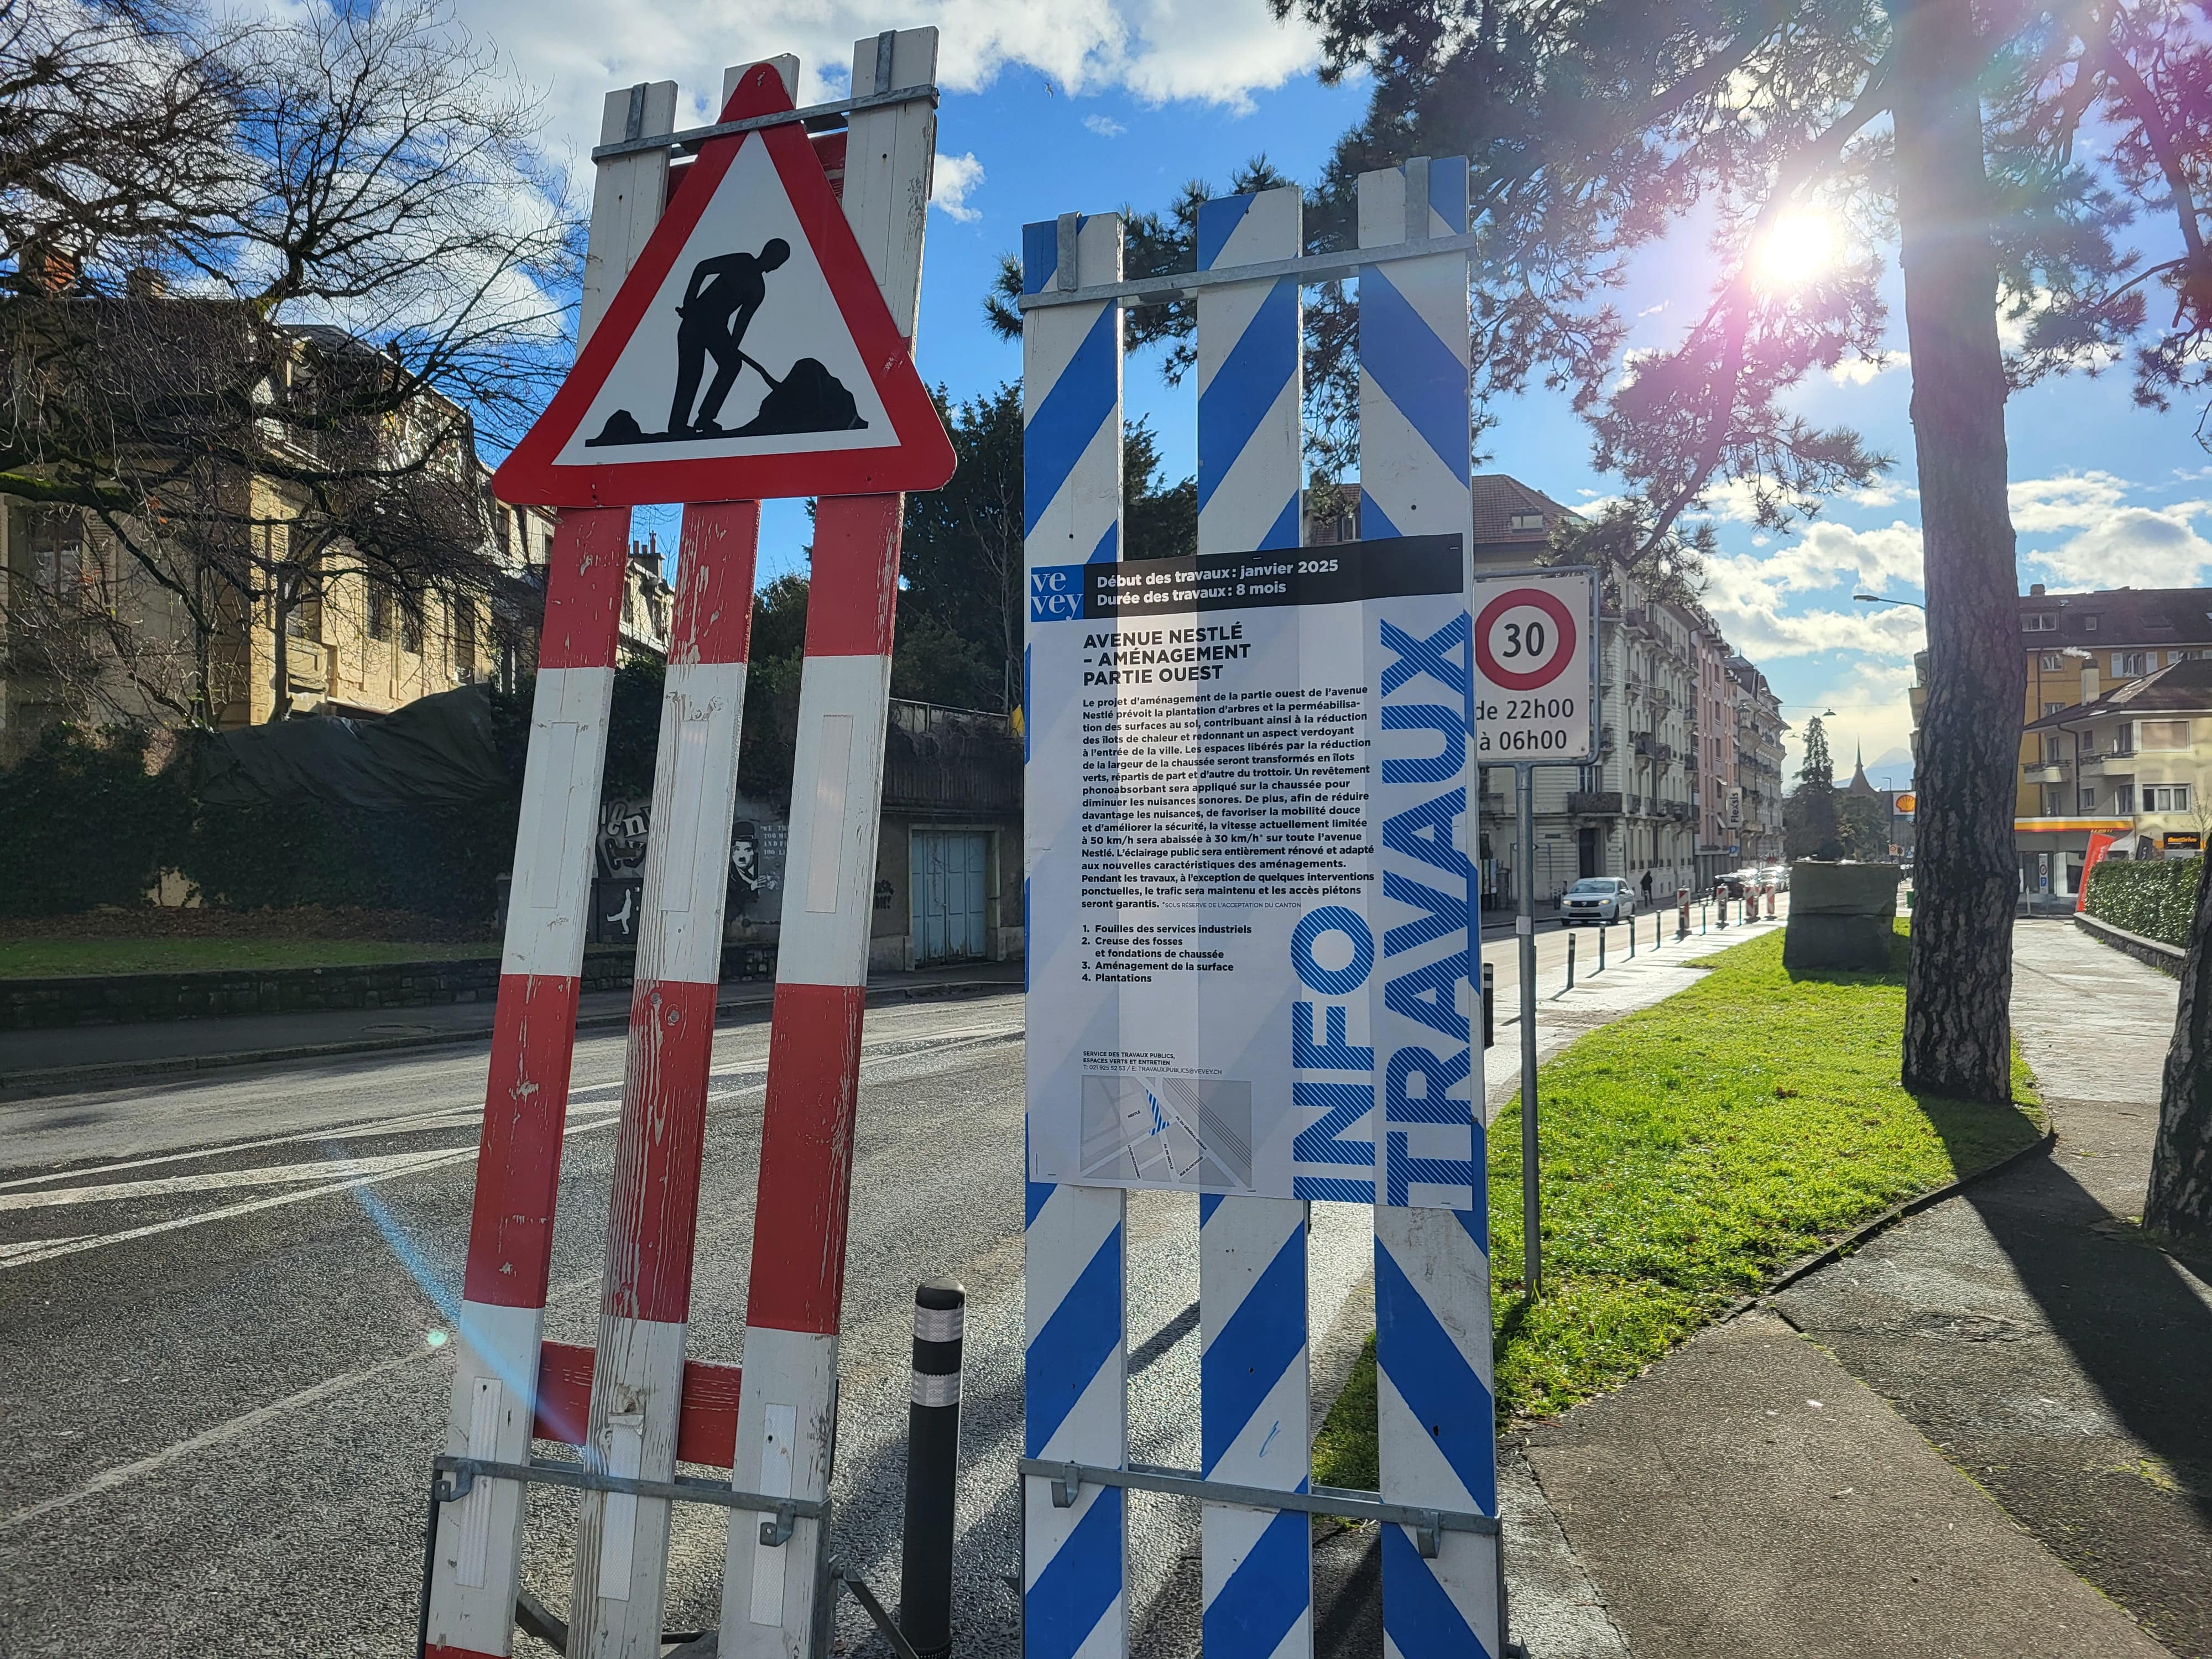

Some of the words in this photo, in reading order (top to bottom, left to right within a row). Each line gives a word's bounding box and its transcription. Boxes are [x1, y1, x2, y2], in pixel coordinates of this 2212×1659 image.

[1097, 573, 1142, 588] Début
[1145, 572, 1172, 586] des
[1239, 562, 1293, 580] janvier
[1298, 559, 1338, 573] 2025
[1097, 591, 1140, 606] Durée
[1143, 590, 1169, 603] des
[1236, 583, 1245, 596] 8
[1249, 581, 1286, 595] mois
[1083, 630, 1163, 649] AVENUE
[1169, 624, 1243, 645] NESTLÉ
[1502, 622, 1545, 658] 30
[1098, 643, 1251, 667] AMÉNAGEMENT
[1083, 669, 1152, 686] PARTIE
[1159, 664, 1223, 683] OUEST
[1083, 698, 1095, 707] Le
[1097, 697, 1128, 708] projet
[1130, 693, 1211, 706] d’aménagement
[1213, 692, 1227, 701] de
[1229, 691, 1238, 701] la
[1241, 690, 1272, 702] partie
[1275, 689, 1306, 698] ouest
[1308, 688, 1322, 697] de
[1325, 687, 1368, 697] l’avenue
[1083, 709, 1114, 720] Nestlé
[1116, 708, 1152, 720] prévoit
[1154, 708, 1163, 717] la
[1166, 706, 1216, 718] plantation
[1218, 704, 1260, 714] d’arbres
[1262, 703, 1274, 712] et
[1276, 702, 1286, 712] la
[1288, 700, 1360, 713] perméabilisa-
[1476, 700, 1498, 721] de
[1506, 698, 1574, 720] 22h00
[1083, 735, 1100, 745] des
[1102, 735, 1124, 744] îlots
[1126, 734, 1139, 744] de
[1141, 733, 1178, 743] chaleur
[1180, 732, 1191, 742] et
[1192, 730, 1244, 741] redonnant
[1262, 728, 1298, 739] aspect
[1300, 726, 1354, 737] verdoyant
[1479, 732, 1491, 751] à
[1499, 729, 1567, 751] 06h00
[1082, 784, 1166, 796] phonoabsorbant
[1168, 785, 1190, 793] sera
[1192, 781, 1237, 794] appliqué
[1259, 781, 1269, 790] la
[1271, 779, 1322, 790] chaussée
[1325, 780, 1350, 790] pour
[1082, 848, 1115, 858] Nestlé.
[1117, 848, 1168, 858] L’éclairage
[1170, 847, 1199, 858] public
[1201, 848, 1222, 857] sera
[1224, 846, 1286, 856] entièrement
[1288, 845, 1324, 855] rénové
[1326, 846, 1337, 855] et
[1339, 844, 1374, 855] adapté
[1102, 860, 1151, 870] nouvelles
[1154, 859, 1235, 871] caractéristiques
[1238, 859, 1256, 869] des
[1259, 859, 1346, 870] aménagements.
[1082, 874, 1122, 883] Pendant
[1124, 874, 1138, 883] les
[1140, 874, 1178, 884] travaux,
[1180, 873, 1186, 883] à
[1188, 873, 1241, 884] l’exception
[1243, 872, 1256, 881] de
[1258, 872, 1305, 883] quelques
[1307, 872, 1374, 882] interventions
[1081, 886, 1142, 897] ponctuelles,
[1145, 886, 1154, 895] le
[1156, 886, 1182, 895] trafic
[1207, 886, 1255, 895] maintenu
[1258, 886, 1269, 895] et
[1271, 885, 1286, 895] les
[1289, 885, 1319, 895] accès
[1322, 885, 1361, 896] piétons
[1081, 899, 1113, 908] seront
[1115, 899, 1160, 910] garantis.
[1380, 613, 1473, 1207] TRAVAUX
[1083, 924, 1090, 933] 1.
[1095, 924, 1134, 933] Fouilles
[1136, 924, 1154, 933] des
[1156, 924, 1196, 933] services
[1198, 924, 1252, 934] industriels
[1082, 936, 1091, 945] 2.
[1095, 936, 1130, 946] Creuse
[1132, 936, 1150, 946] des
[1152, 936, 1183, 946] fosses
[1095, 949, 1105, 958] et
[1107, 948, 1162, 958] fondations
[1164, 949, 1177, 958] de
[1178, 949, 1224, 959] chaussée
[1082, 961, 1091, 970] 3.
[1095, 961, 1169, 972] Aménagement
[1171, 961, 1183, 971] de
[1186, 961, 1194, 971] la
[1197, 962, 1234, 971] surface
[1082, 973, 1091, 982] 4.
[1095, 973, 1152, 983] Plantations
[1290, 905, 1376, 1204] INFO
